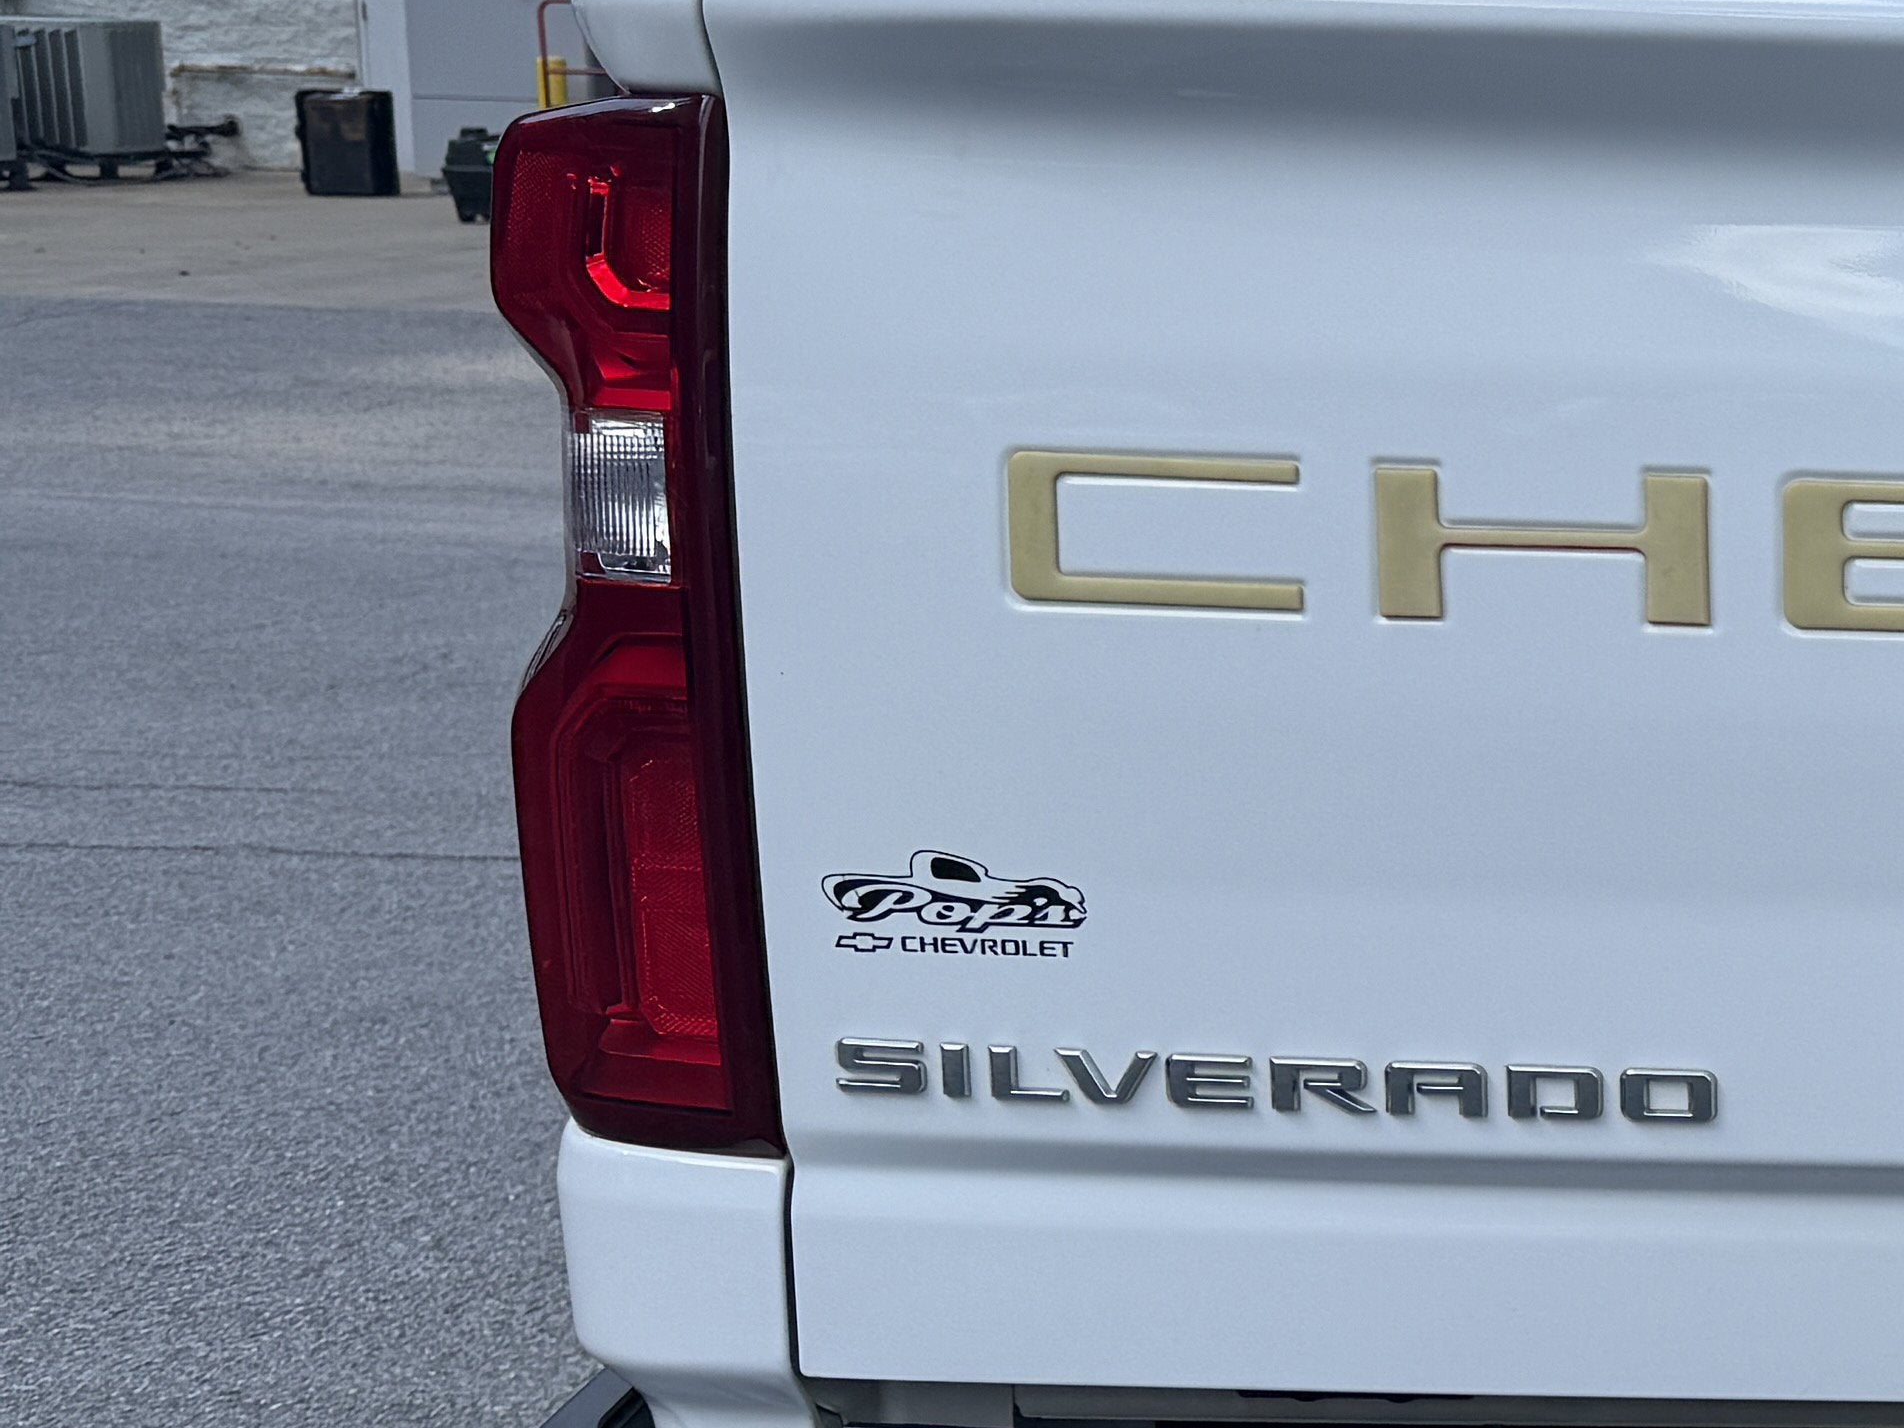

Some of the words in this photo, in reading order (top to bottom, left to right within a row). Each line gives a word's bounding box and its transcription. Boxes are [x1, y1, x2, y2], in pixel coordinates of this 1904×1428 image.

[841, 884, 1073, 932] Pop's
[901, 936, 1074, 958] CHEVROLET
[835, 1037, 1718, 1122] SILVERADO
